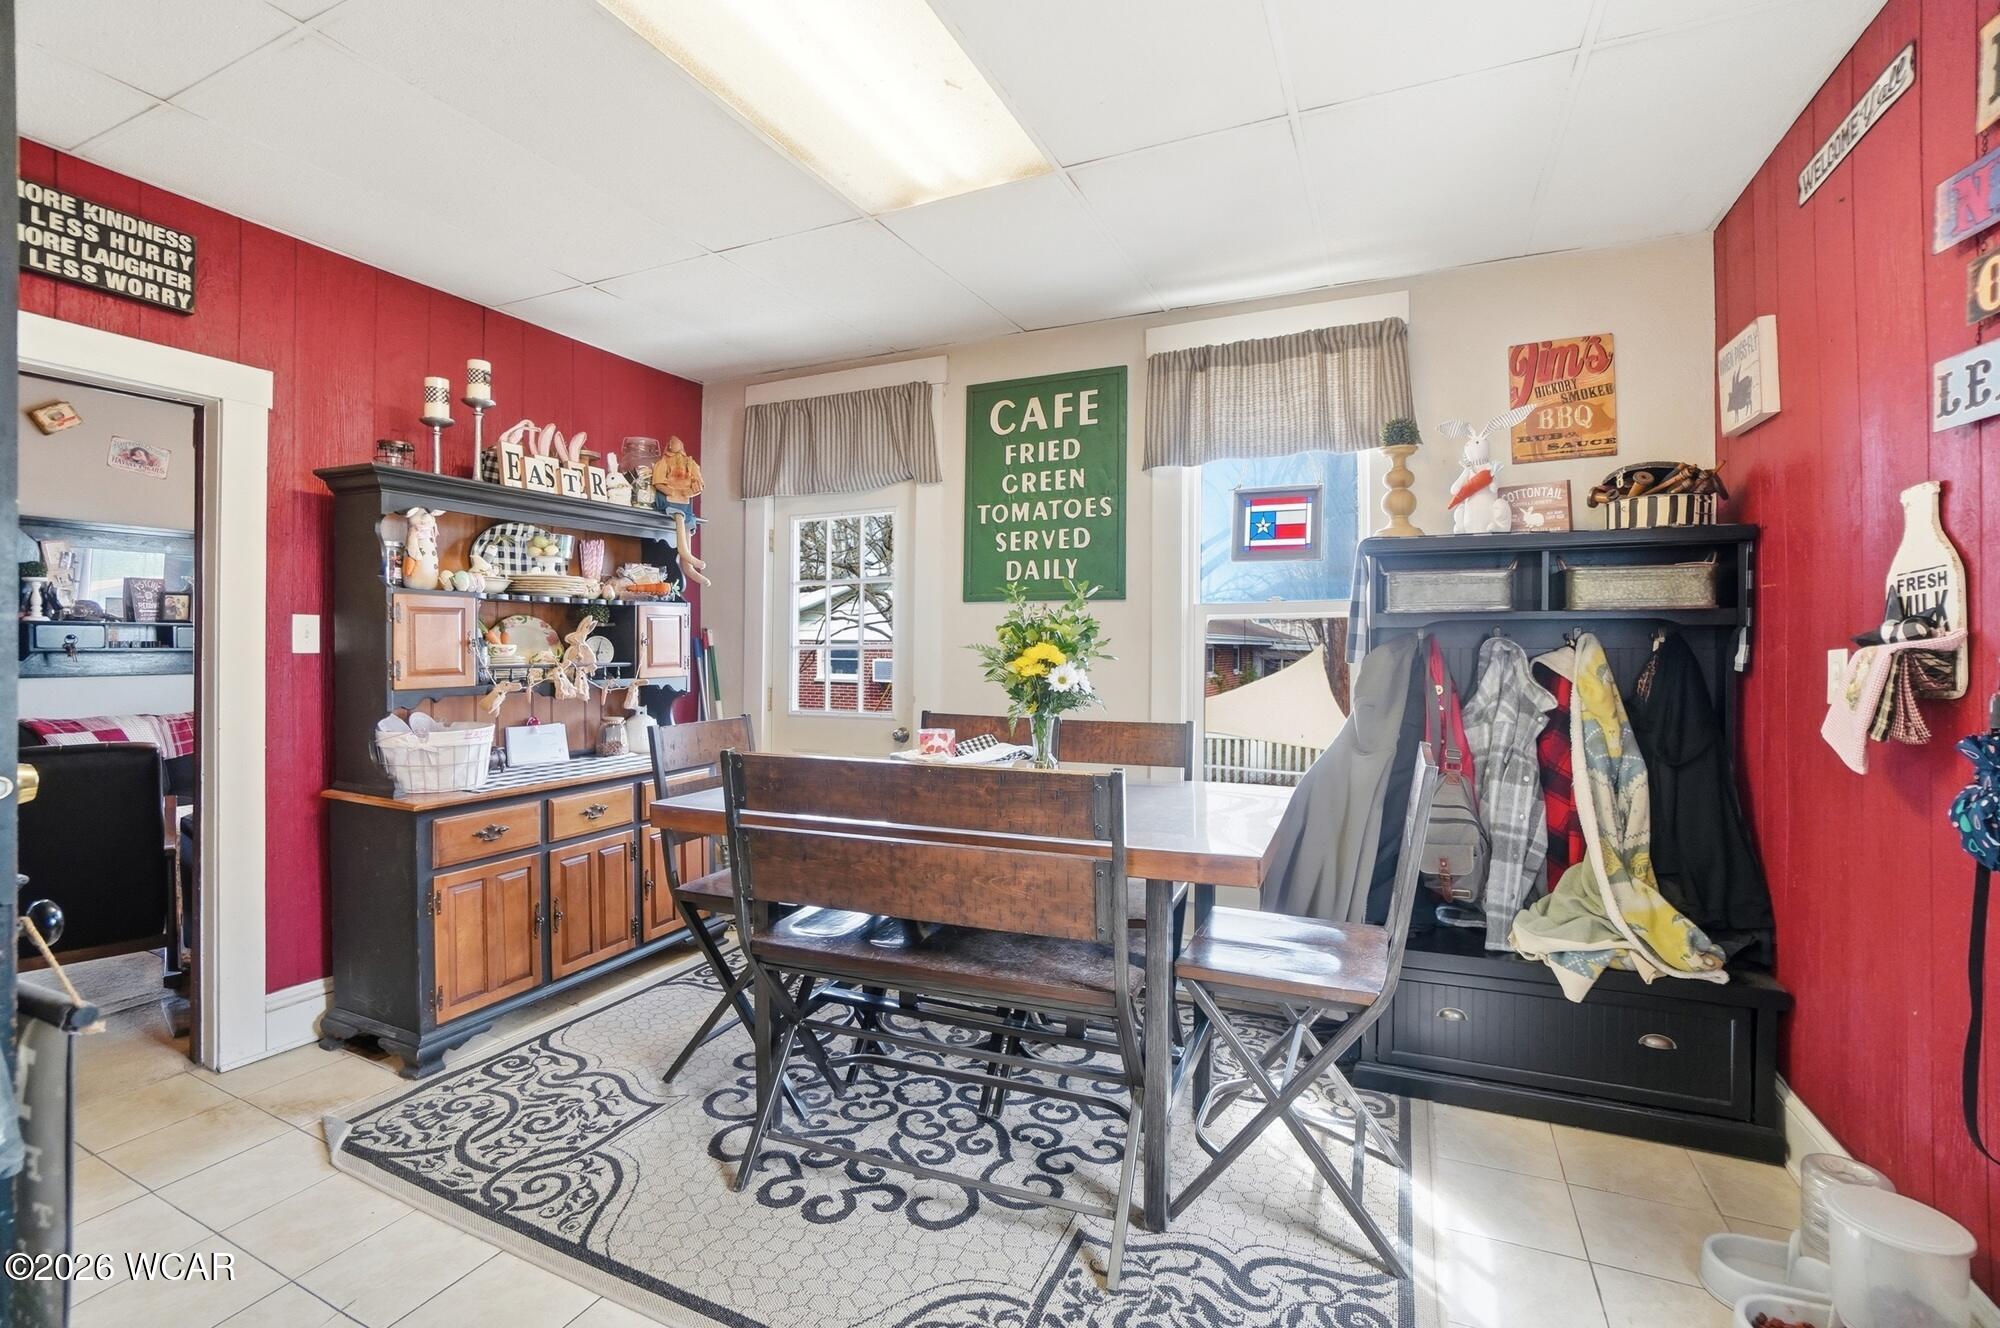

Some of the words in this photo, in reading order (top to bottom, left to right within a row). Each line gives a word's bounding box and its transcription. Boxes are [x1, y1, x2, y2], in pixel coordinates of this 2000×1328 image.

[1802, 113, 1860, 194] WELCOME
[30, 205, 100, 243] LESS
[110, 231, 194, 272] HURRY
[83, 201, 193, 252] KINDNESS
[29, 248, 98, 283] LESS
[105, 270, 192, 310] WORRY
[81, 242, 193, 292] LAUGHTER
[1534, 379, 1578, 399] HICKORY
[1936, 359, 2000, 418] LE
[989, 389, 1099, 436] CAFE
[1537, 404, 1594, 430] BBQ
[1004, 438, 1081, 465] FRIED
[1517, 432, 1563, 444] RUB
[1547, 437, 1616, 451] SAUCE
[1501, 486, 1563, 503] COTTONTAIL
[977, 496, 1113, 524] TOMATOES
[995, 527, 1091, 553] SERVED
[1006, 558, 1078, 581] DAILY
[1897, 570, 1948, 594] FRESH
